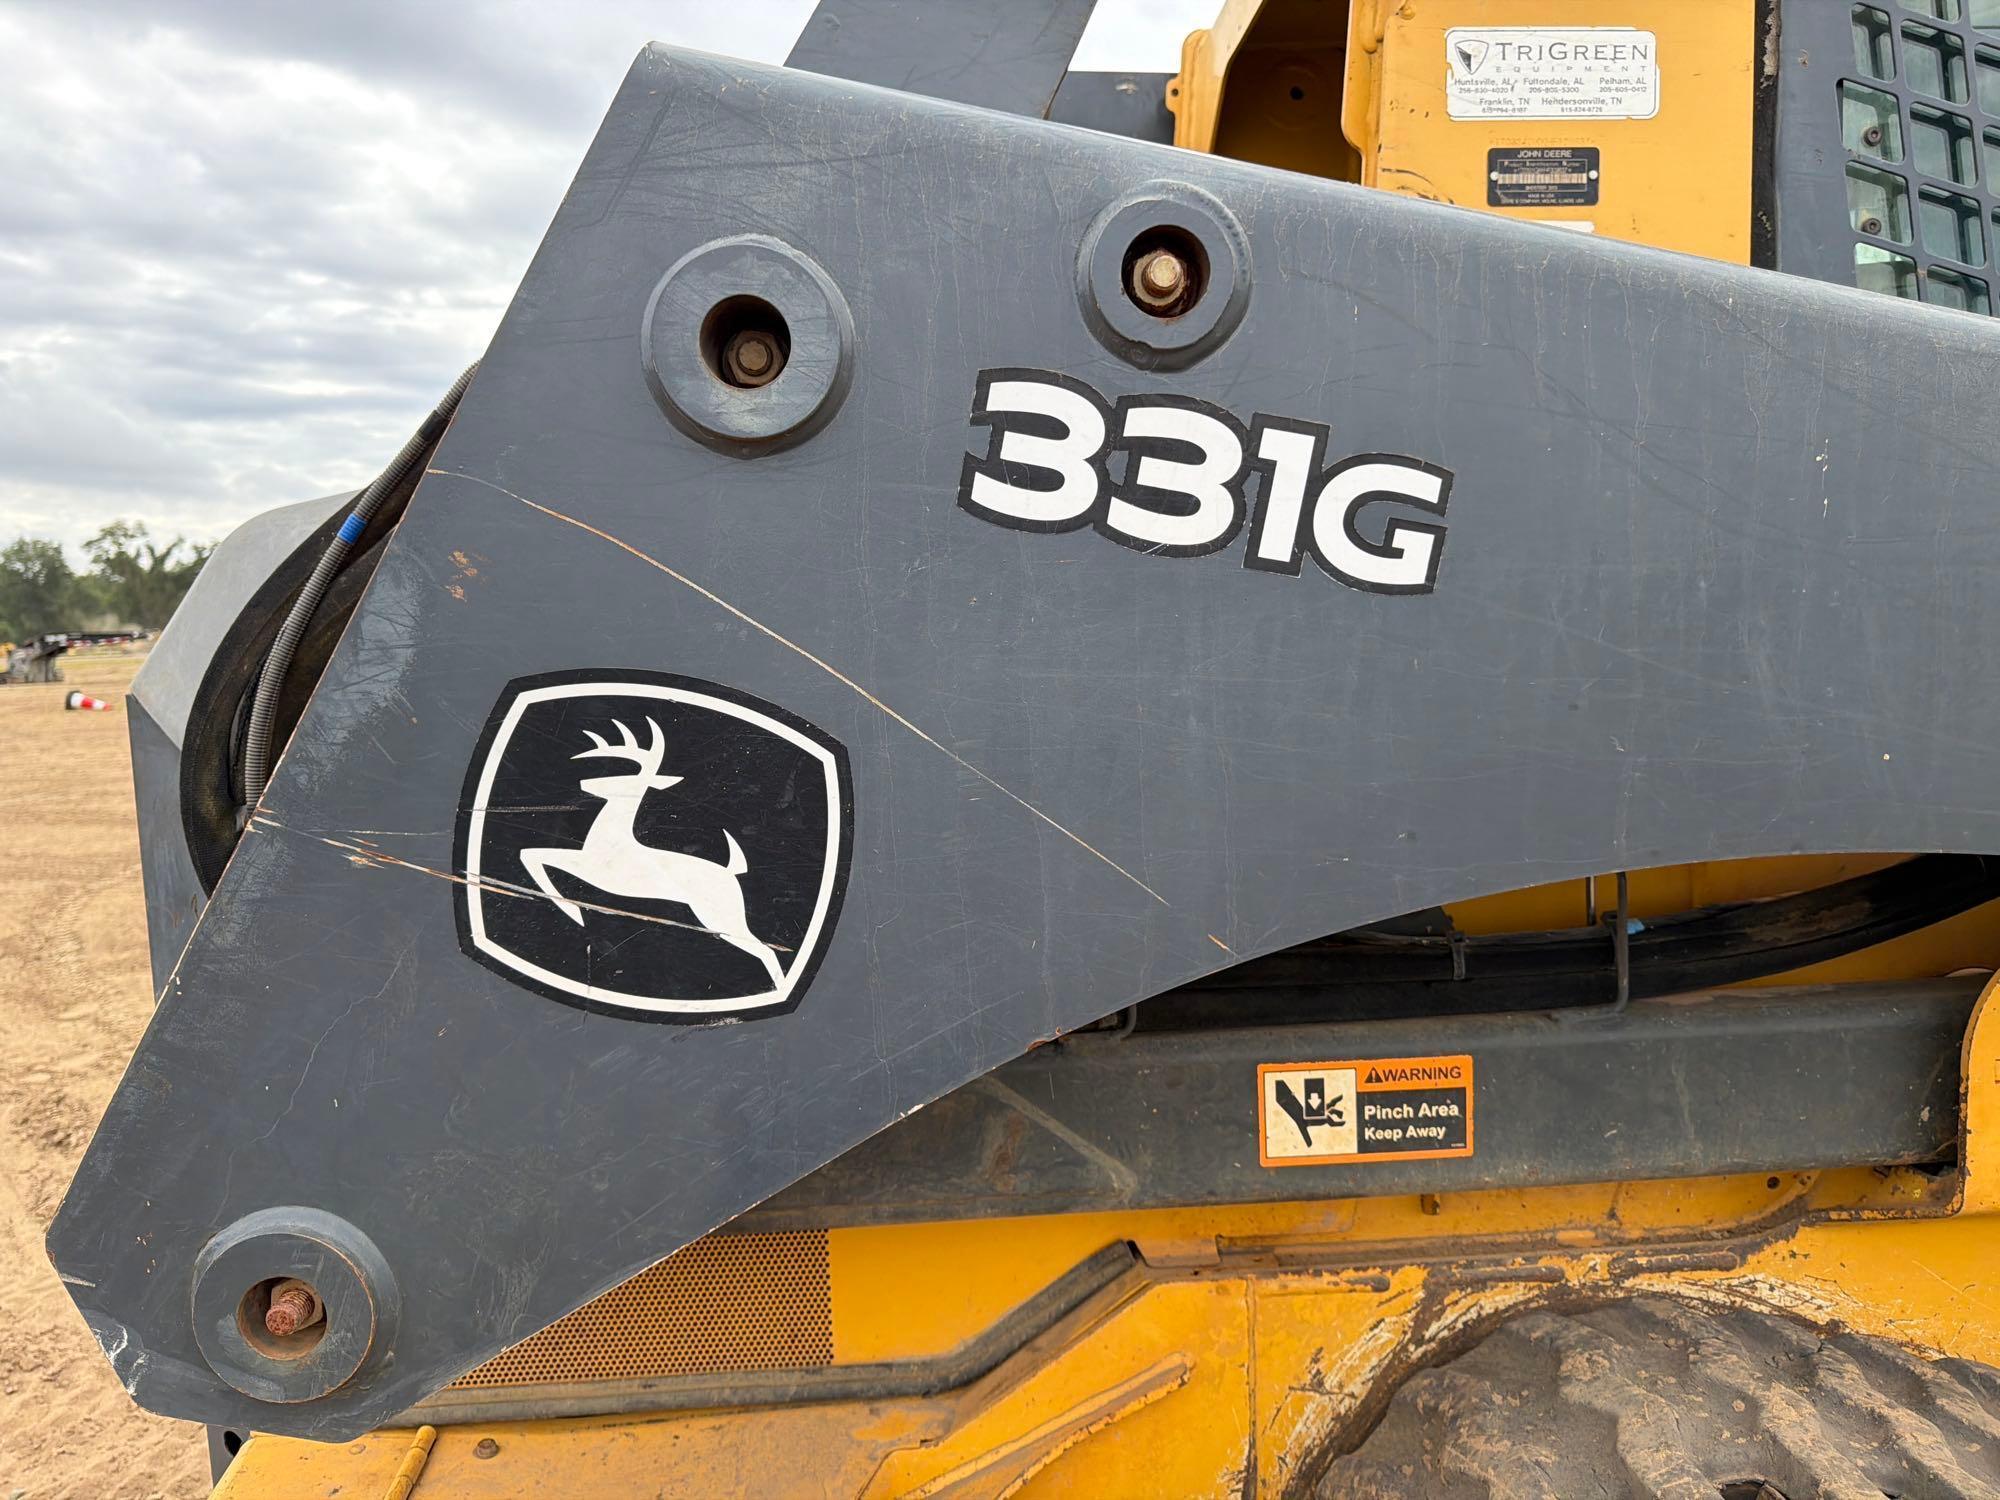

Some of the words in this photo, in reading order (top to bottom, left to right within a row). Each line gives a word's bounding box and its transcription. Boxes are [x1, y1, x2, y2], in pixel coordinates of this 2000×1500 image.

[1495, 65, 1648, 73] EQUIPMENT
[1454, 77, 1498, 87] Huntsville,
[1501, 77, 1512, 86] AL
[1523, 77, 1568, 87] Fultondale,
[1573, 77, 1584, 86] AL
[1599, 77, 1632, 87] Pelham,
[1635, 77, 1647, 86] AL
[1479, 97, 1515, 106] Franklin,
[1610, 97, 1622, 105] TN
[1517, 150, 1542, 158] JOHN
[1543, 150, 1572, 158] DEERE
[968, 378, 1445, 587] 331G
[1382, 1065, 1462, 1082] WARNING
[1363, 1103, 1414, 1120] Pinch
[1418, 1101, 1460, 1117] Area
[1363, 1126, 1403, 1142] Keep
[1405, 1124, 1447, 1140] Away
